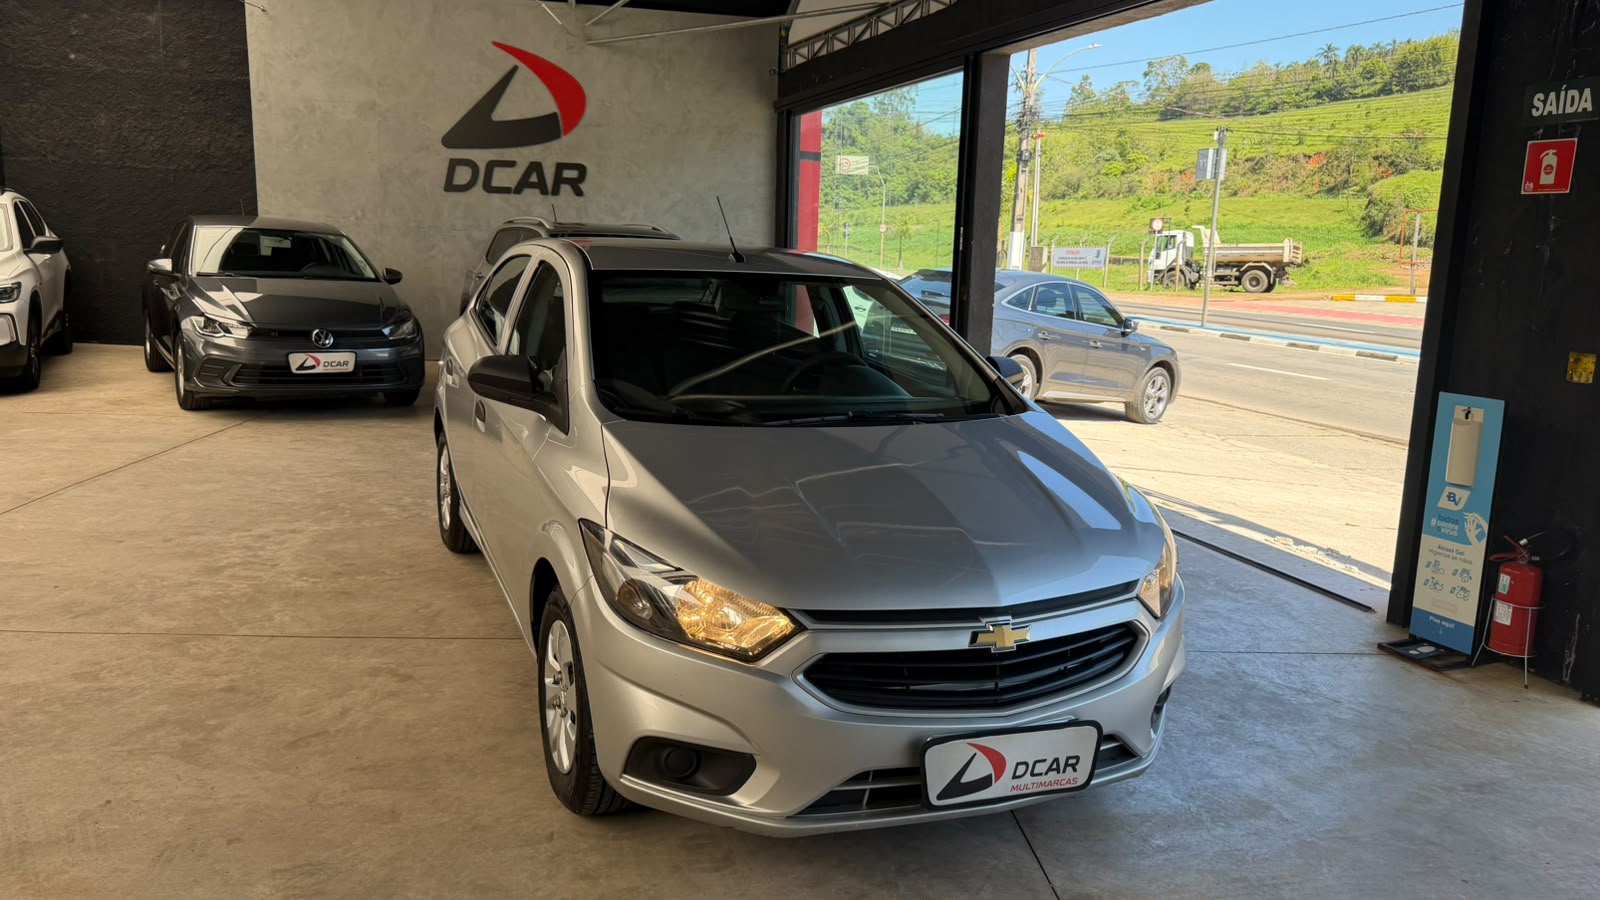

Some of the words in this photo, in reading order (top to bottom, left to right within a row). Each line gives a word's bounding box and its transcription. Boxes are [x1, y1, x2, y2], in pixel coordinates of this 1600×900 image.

[1531, 84, 1593, 117] SAÍDA
[443, 157, 588, 197] DCAR
[322, 360, 349, 368] DCAR
[1011, 755, 1081, 780] DCAR
[1010, 777, 1079, 792] MULTIMARCAS
